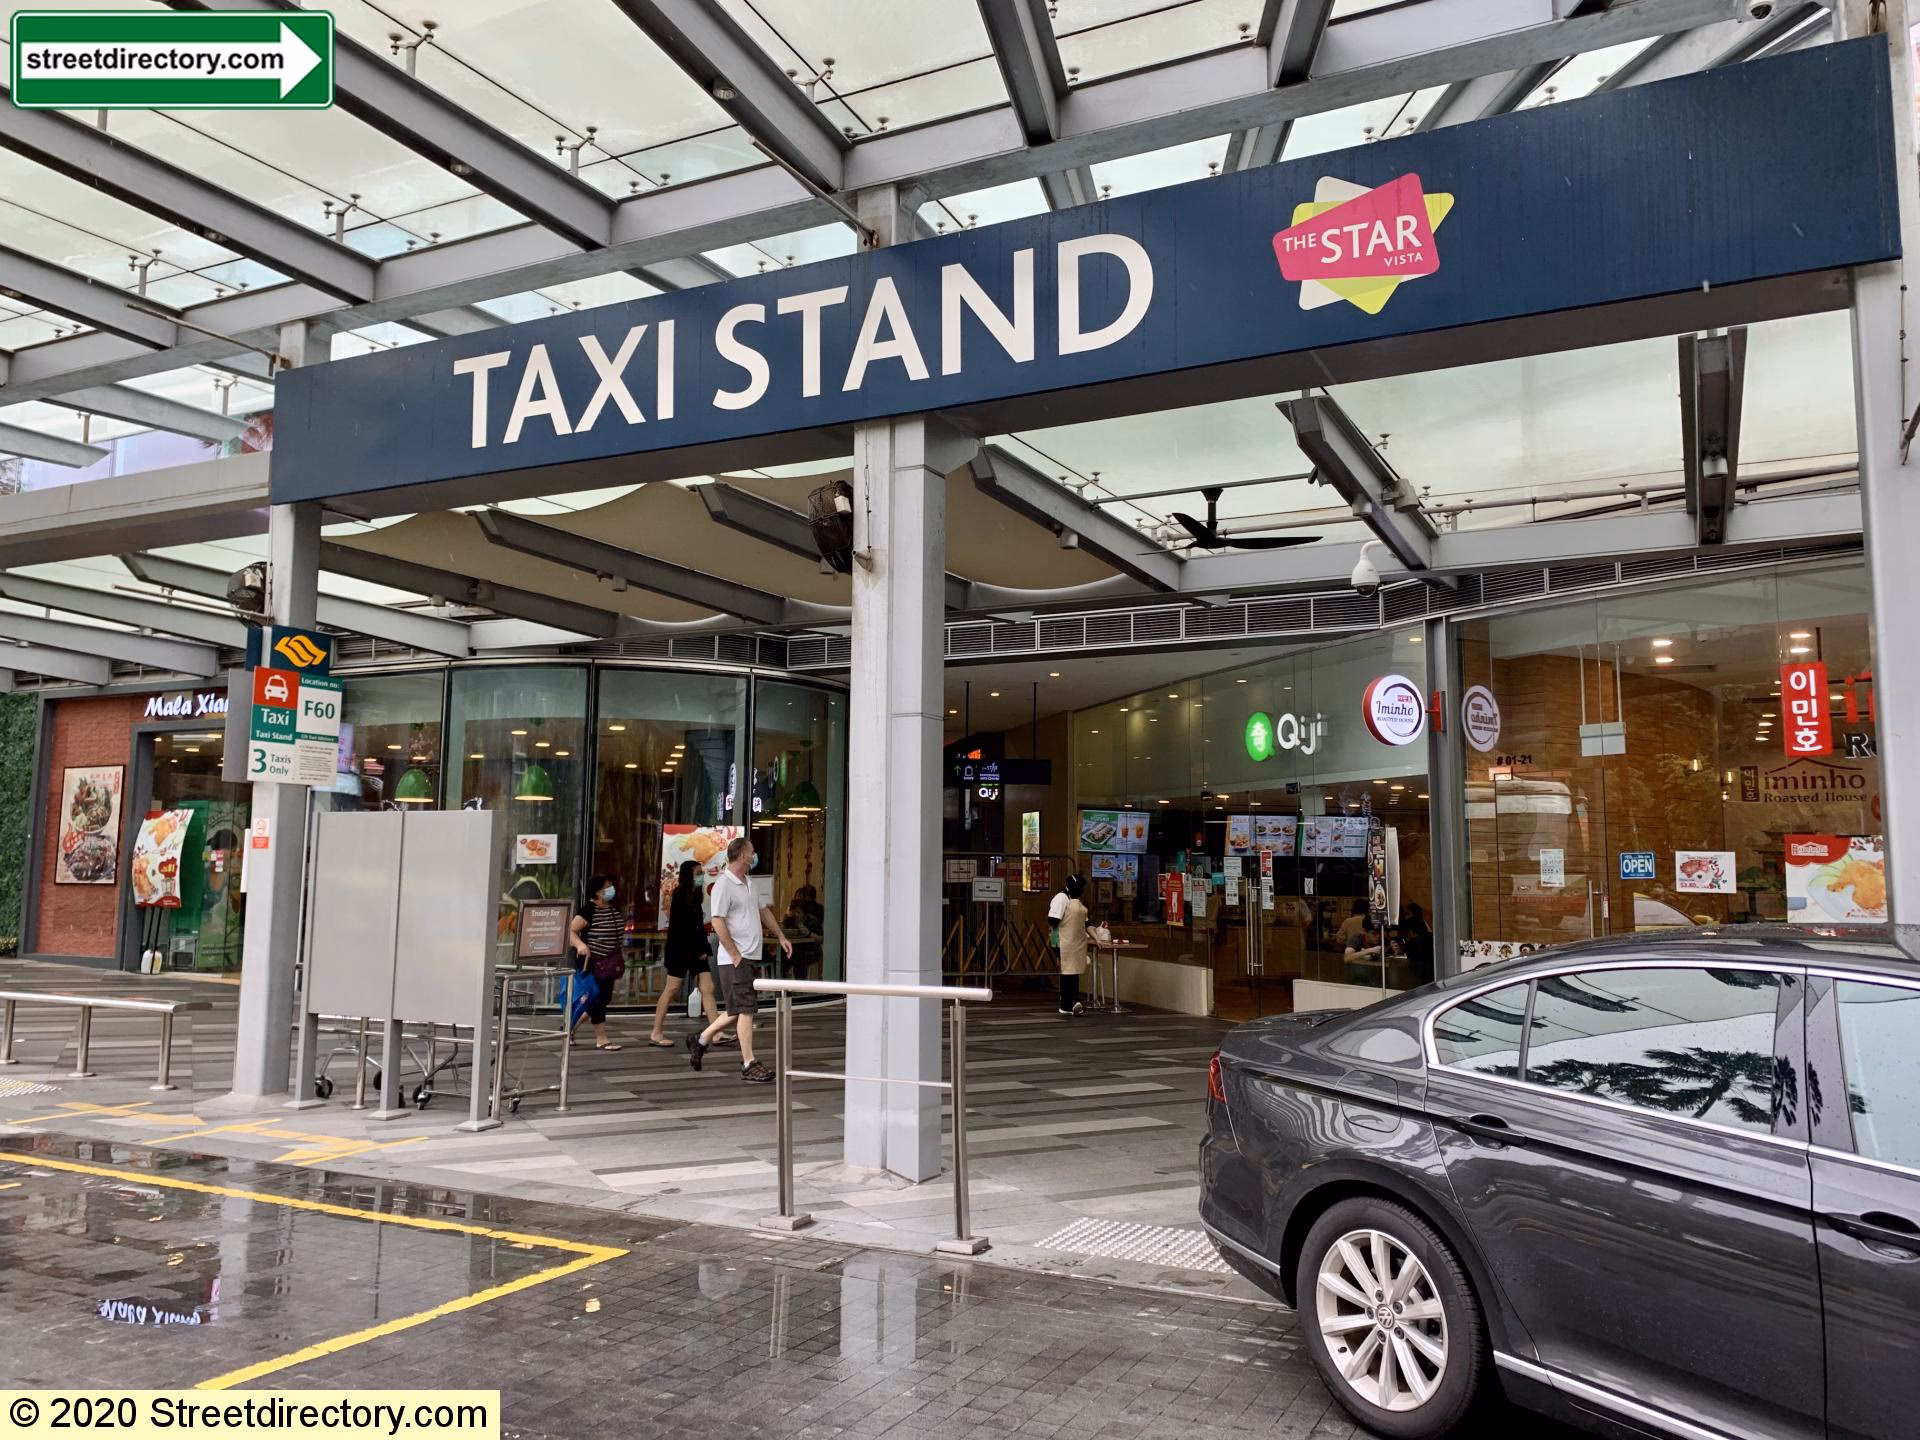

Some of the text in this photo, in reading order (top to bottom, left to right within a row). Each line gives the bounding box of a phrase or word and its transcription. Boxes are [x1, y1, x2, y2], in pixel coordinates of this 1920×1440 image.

[1282, 214, 1423, 264] THE STAR
[1383, 251, 1424, 267] VISTA
[453, 233, 1155, 450] TAXI STAND
[301, 677, 328, 687] Location
[144, 694, 192, 717] Mala
[304, 700, 335, 720] F60
[1789, 668, 1823, 752] 이민호
[260, 708, 290, 726] Taxi
[256, 729, 271, 740] Taxi
[271, 731, 293, 742] Stand
[1277, 712, 1322, 755] Qiji
[251, 748, 267, 774] 3
[270, 754, 292, 764] Taxis
[269, 765, 289, 776] Only
[1764, 769, 1866, 790] iminho
[1764, 792, 1867, 803] Roasted House
[1623, 859, 1653, 873] OPEN
